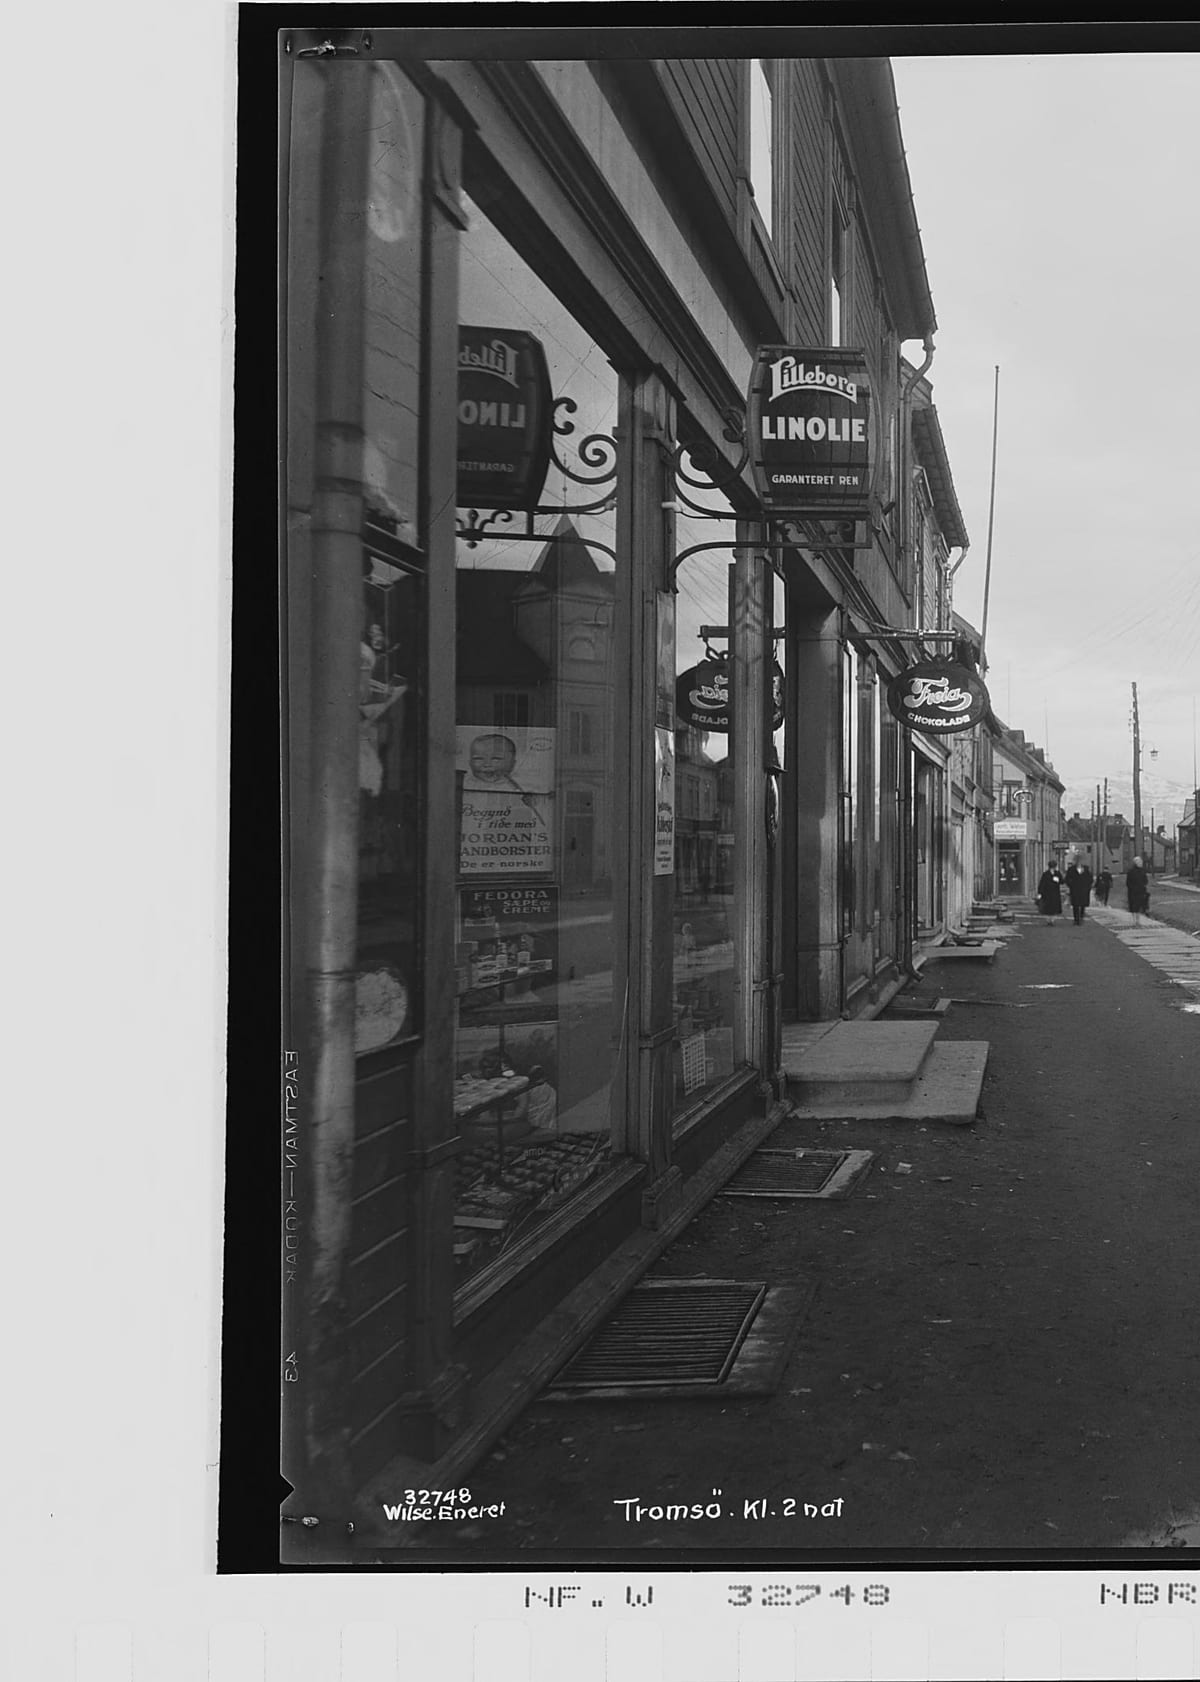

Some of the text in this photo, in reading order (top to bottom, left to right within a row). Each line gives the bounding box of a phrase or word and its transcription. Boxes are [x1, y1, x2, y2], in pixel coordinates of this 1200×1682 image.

[769, 356, 858, 403] Lilleborg
[762, 416, 865, 442] LINOLIE
[772, 474, 859, 485] GARANTERET REN
[903, 677, 973, 712] Freia
[907, 712, 971, 726] CHOKOLADE
[460, 845, 551, 857] ANDBØRSTER
[461, 859, 544, 868] De er norske
[474, 890, 549, 901] FEDORA
[503, 906, 551, 914] CREME
